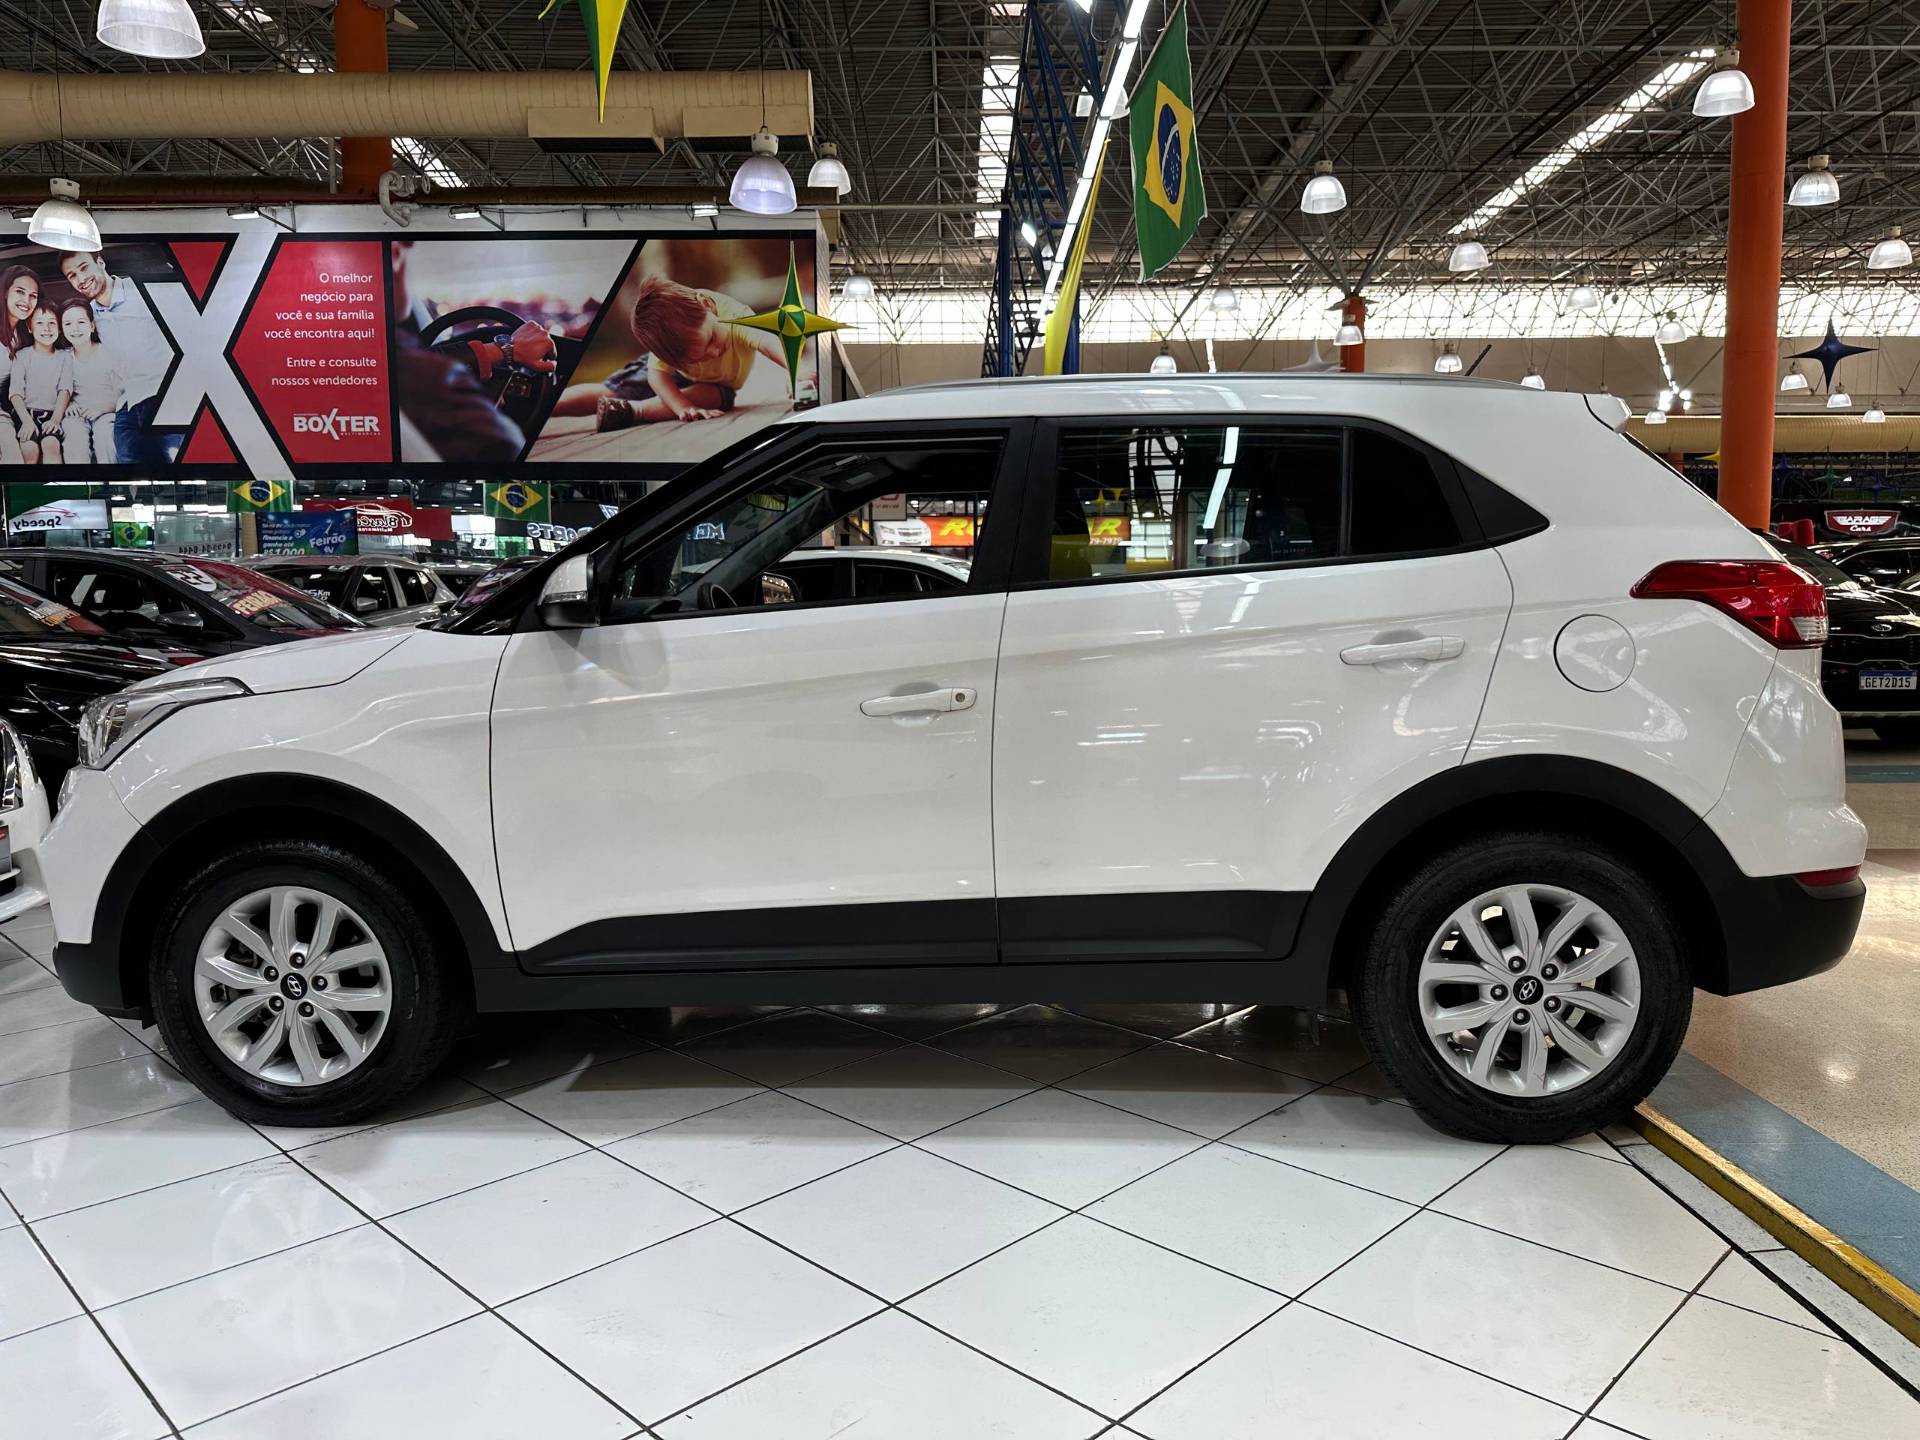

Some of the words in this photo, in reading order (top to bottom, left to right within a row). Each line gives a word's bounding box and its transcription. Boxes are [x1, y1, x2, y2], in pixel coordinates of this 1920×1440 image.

[319, 272, 330, 284] O
[332, 272, 373, 284] melhor
[300, 291, 346, 304] negócio
[349, 293, 374, 304] para
[275, 309, 303, 320] você
[305, 311, 313, 320] e
[315, 311, 335, 320] sua
[337, 309, 375, 320] família
[264, 328, 292, 339] você
[294, 329, 345, 339] encontra
[347, 328, 375, 341] aqui!
[286, 357, 316, 368] Entre
[318, 359, 326, 368] e
[328, 356, 377, 368] consulte
[271, 376, 310, 386] nossos
[312, 375, 378, 386] vendedores
[293, 408, 380, 440] BOXTER
[1832, 515, 1892, 526] GARAGE
[309, 533, 346, 548] Feirão
